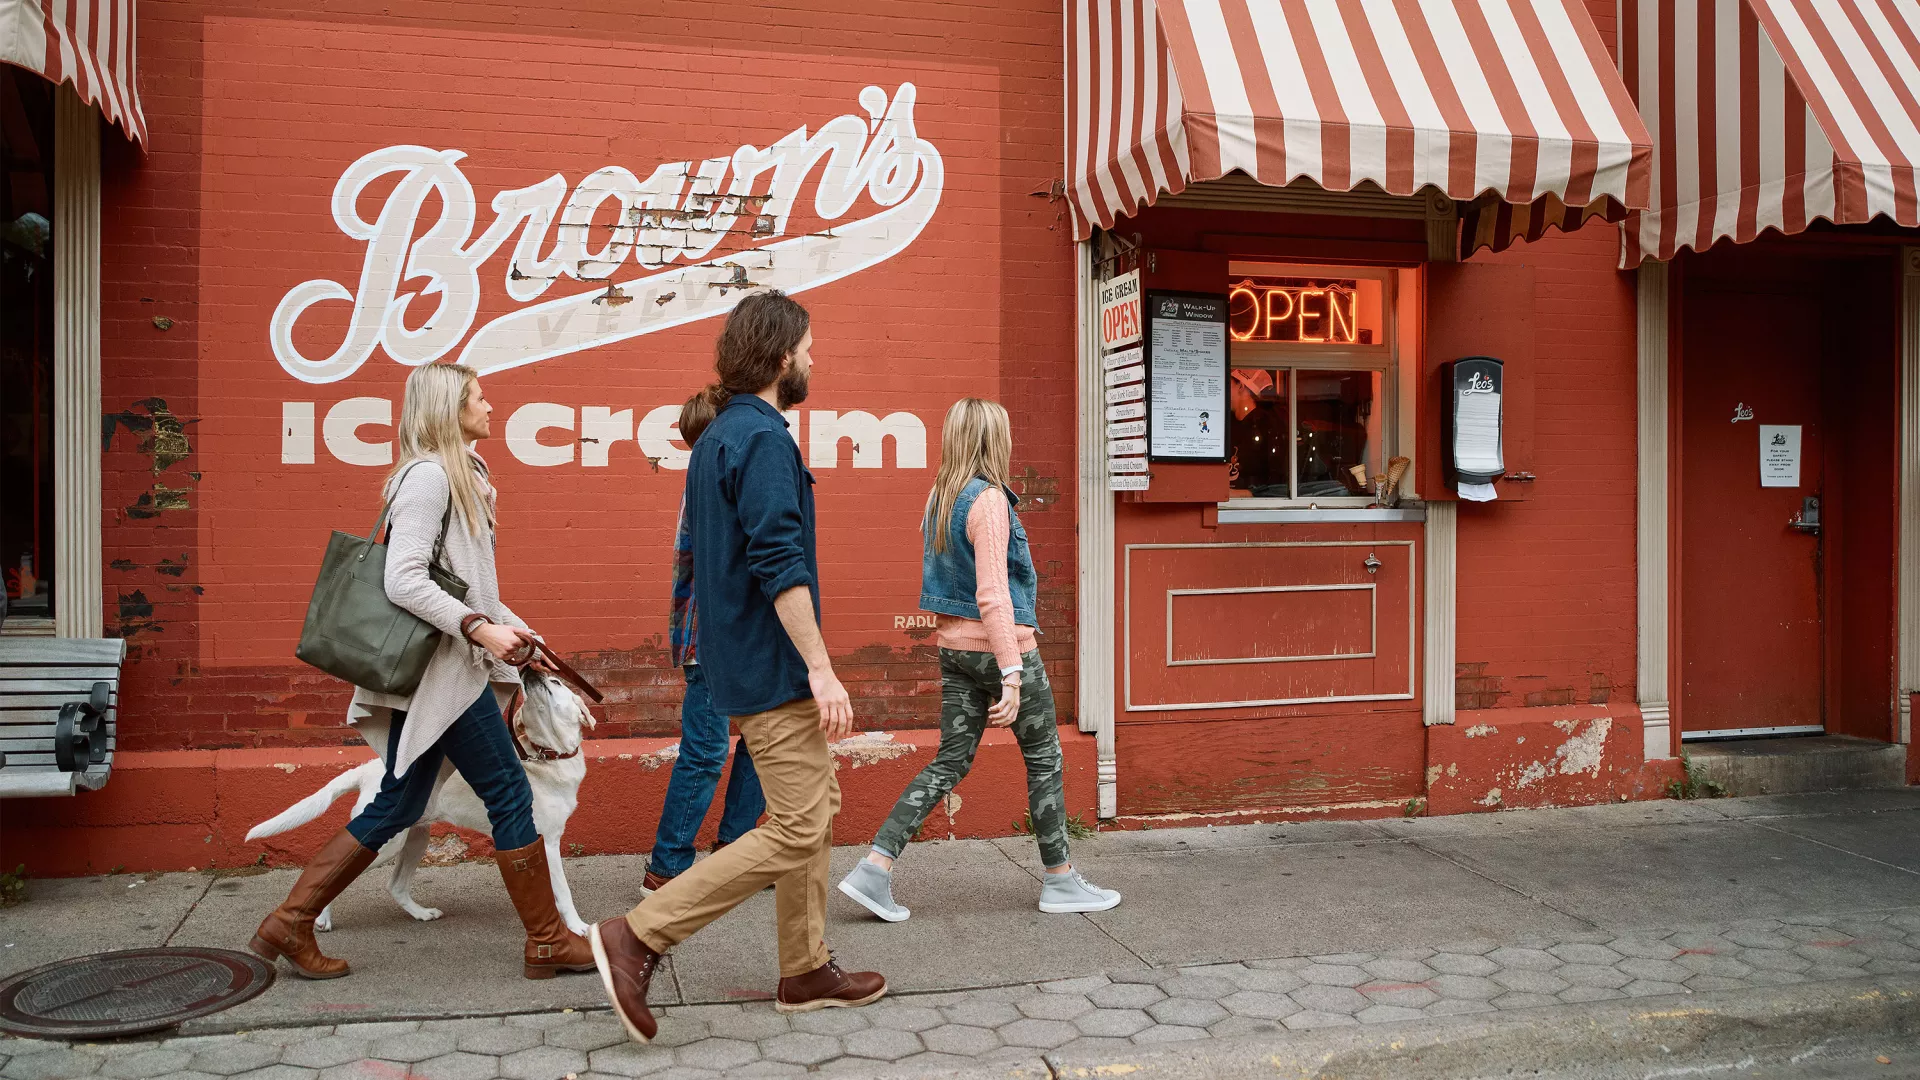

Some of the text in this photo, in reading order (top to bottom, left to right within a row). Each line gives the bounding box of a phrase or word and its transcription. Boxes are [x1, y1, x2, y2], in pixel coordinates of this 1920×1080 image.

[270, 82, 944, 384] Brown's
[1102, 288, 1114, 305] ICE
[1103, 299, 1139, 344] OPEN
[1230, 288, 1357, 342] OPEN
[1113, 371, 1131, 382] Chocolate
[1463, 371, 1494, 396] Leo's
[1116, 389, 1125, 399] York
[1125, 387, 1139, 397] Vanilla
[1115, 406, 1136, 417] Strawberry
[1731, 402, 1754, 424] Leo's
[505, 402, 927, 470] crem
[1110, 461, 1122, 470] Cookies
[1129, 461, 1143, 470] Cream
